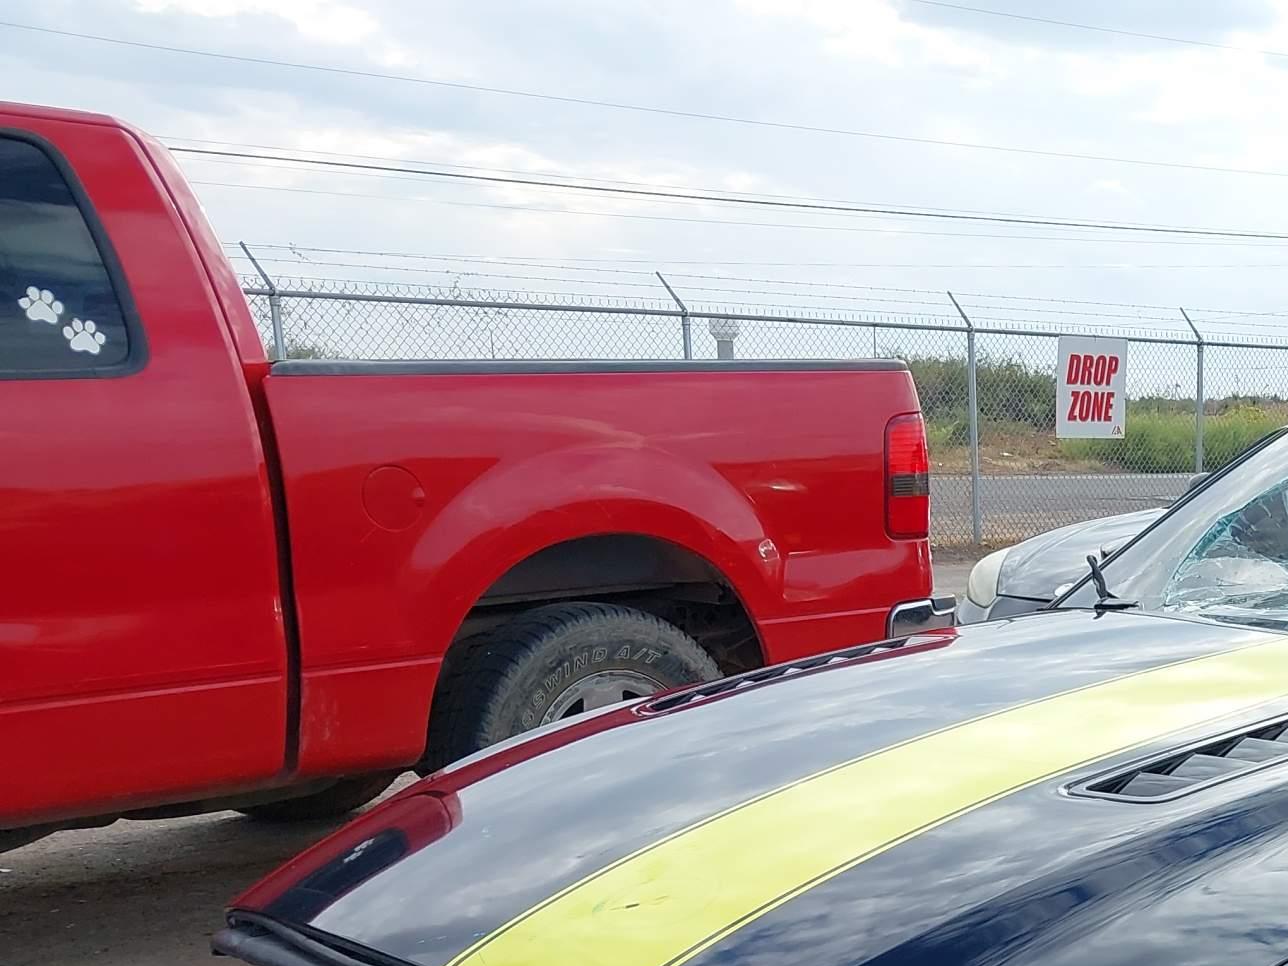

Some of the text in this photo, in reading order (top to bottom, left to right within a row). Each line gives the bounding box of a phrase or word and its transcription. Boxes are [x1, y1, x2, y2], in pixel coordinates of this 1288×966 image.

[1066, 353, 1119, 386] DROP
[1067, 390, 1115, 422] ZONE
[615, 645, 661, 664] A/T
